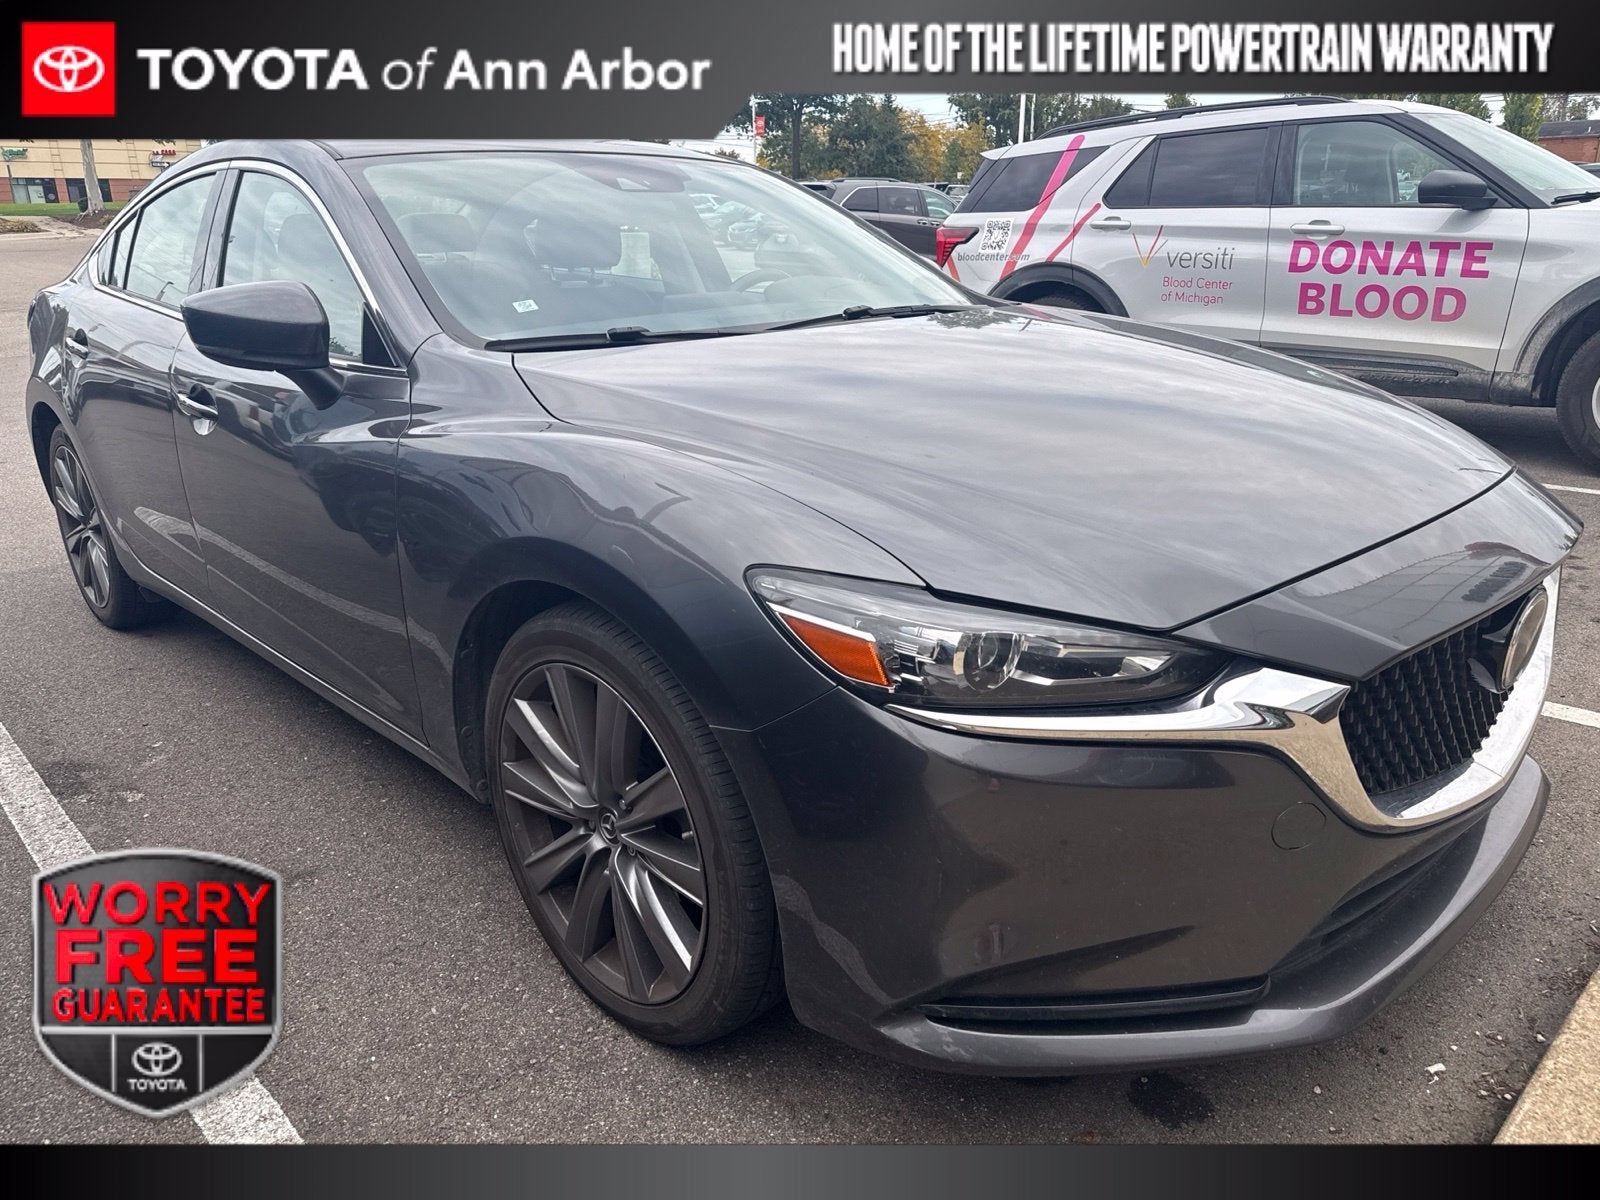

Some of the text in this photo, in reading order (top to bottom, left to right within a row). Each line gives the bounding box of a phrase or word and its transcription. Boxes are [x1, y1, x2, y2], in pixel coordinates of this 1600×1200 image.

[1166, 247, 1235, 270] versiti
[1288, 240, 1494, 278] DONATE
[1162, 276, 1233, 290] Blood Center
[1161, 291, 1224, 306] of Michigan
[1297, 282, 1467, 323] BLOOD
